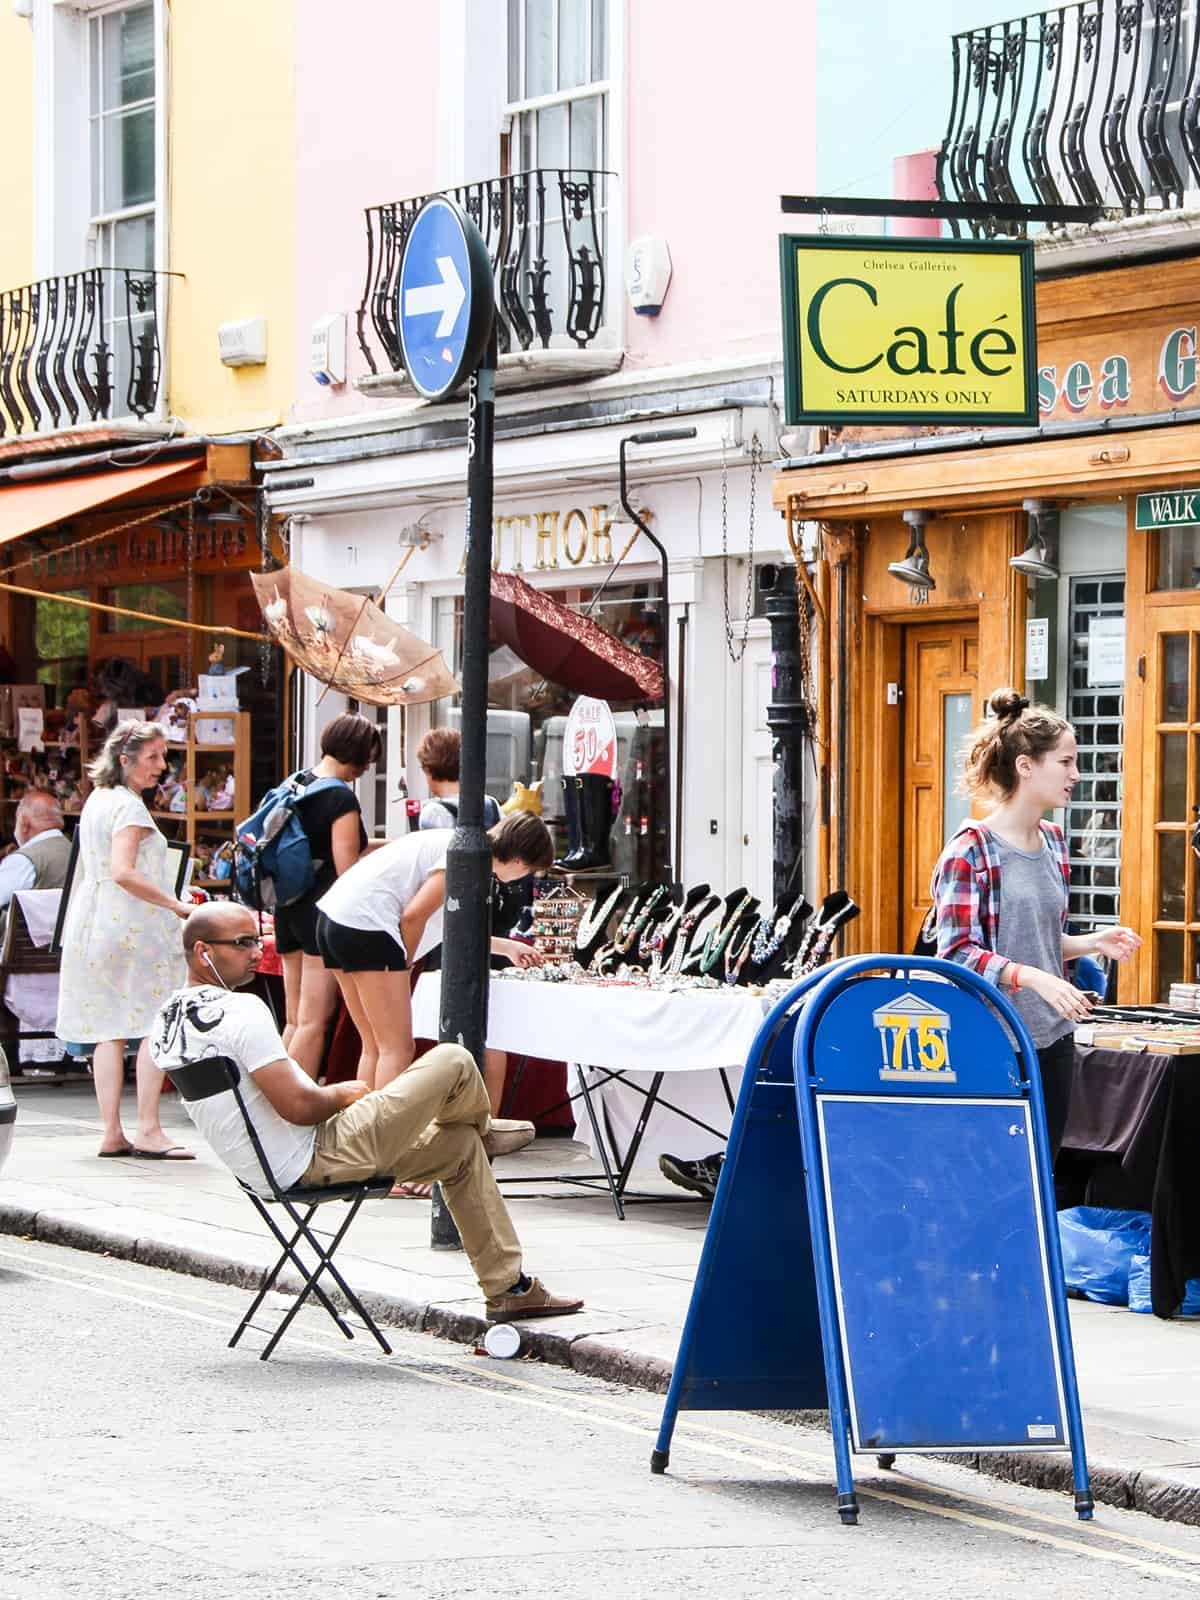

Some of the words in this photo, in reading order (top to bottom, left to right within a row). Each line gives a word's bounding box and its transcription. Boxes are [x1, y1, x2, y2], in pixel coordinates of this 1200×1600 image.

[863, 260, 905, 271] Chelsea
[909, 261, 957, 272] Galleries
[806, 276, 1017, 377] Café
[836, 389, 939, 404] SATURDAYS
[945, 390, 992, 405] ONLY
[1149, 492, 1197, 521] WALK
[882, 1014, 946, 1070] 75
